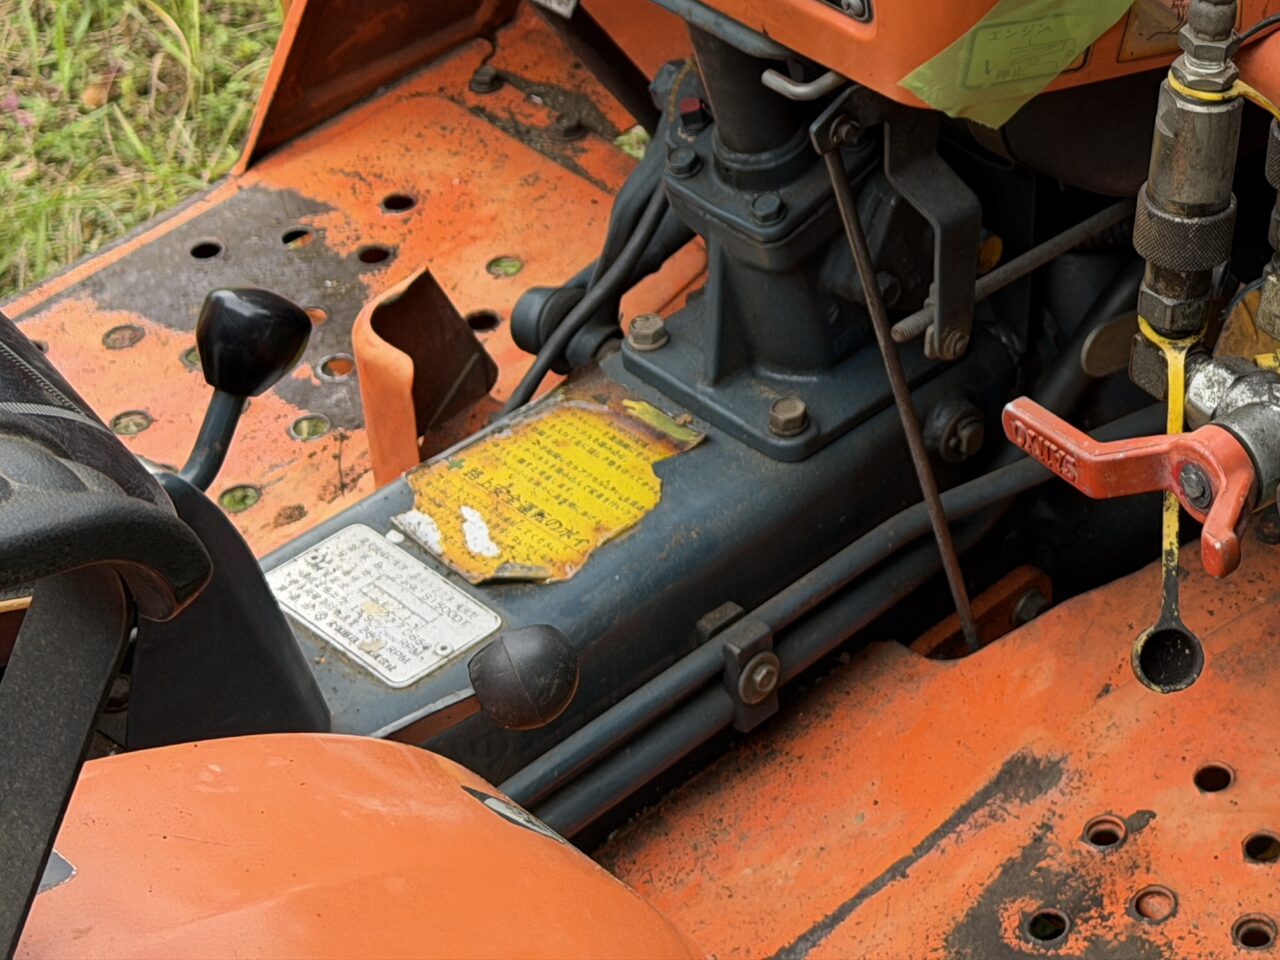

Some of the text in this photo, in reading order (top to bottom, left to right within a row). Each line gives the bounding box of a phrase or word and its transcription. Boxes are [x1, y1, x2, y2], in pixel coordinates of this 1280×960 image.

[463, 466, 590, 549] 路上安全運転のポイ
